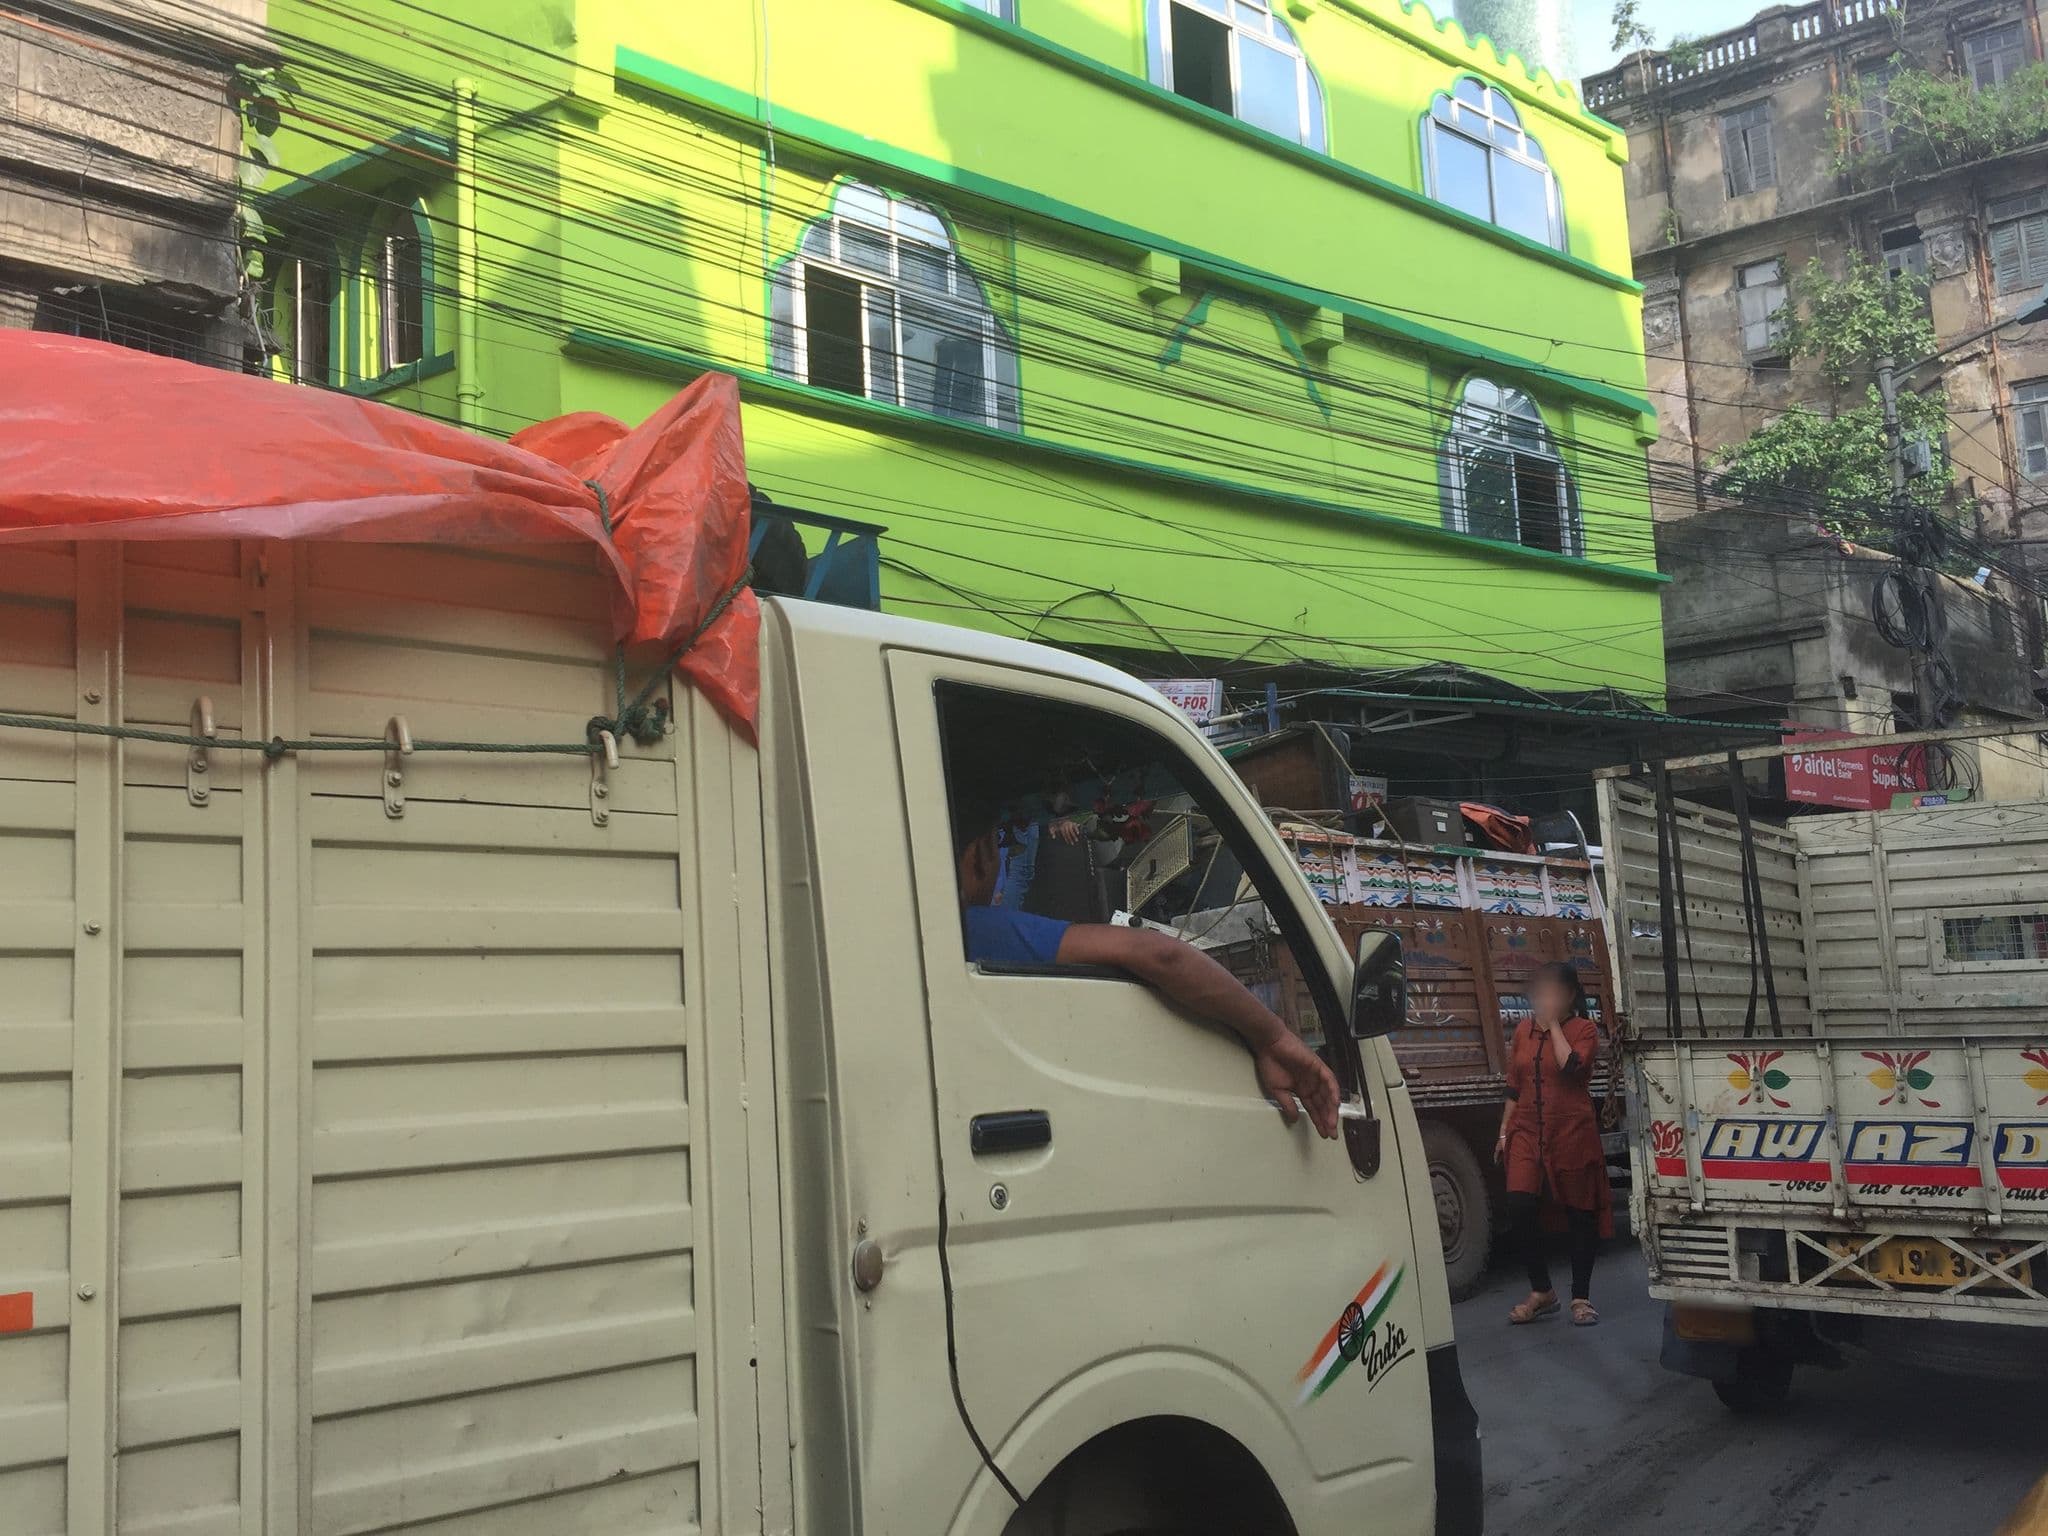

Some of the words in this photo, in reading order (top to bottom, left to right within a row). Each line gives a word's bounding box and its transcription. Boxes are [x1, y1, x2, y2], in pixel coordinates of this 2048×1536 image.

[1804, 753, 1837, 778] airtel
[1837, 759, 1864, 771] Payments
[1838, 770, 1853, 780] Bank
[1361, 1321, 1409, 1383] India
